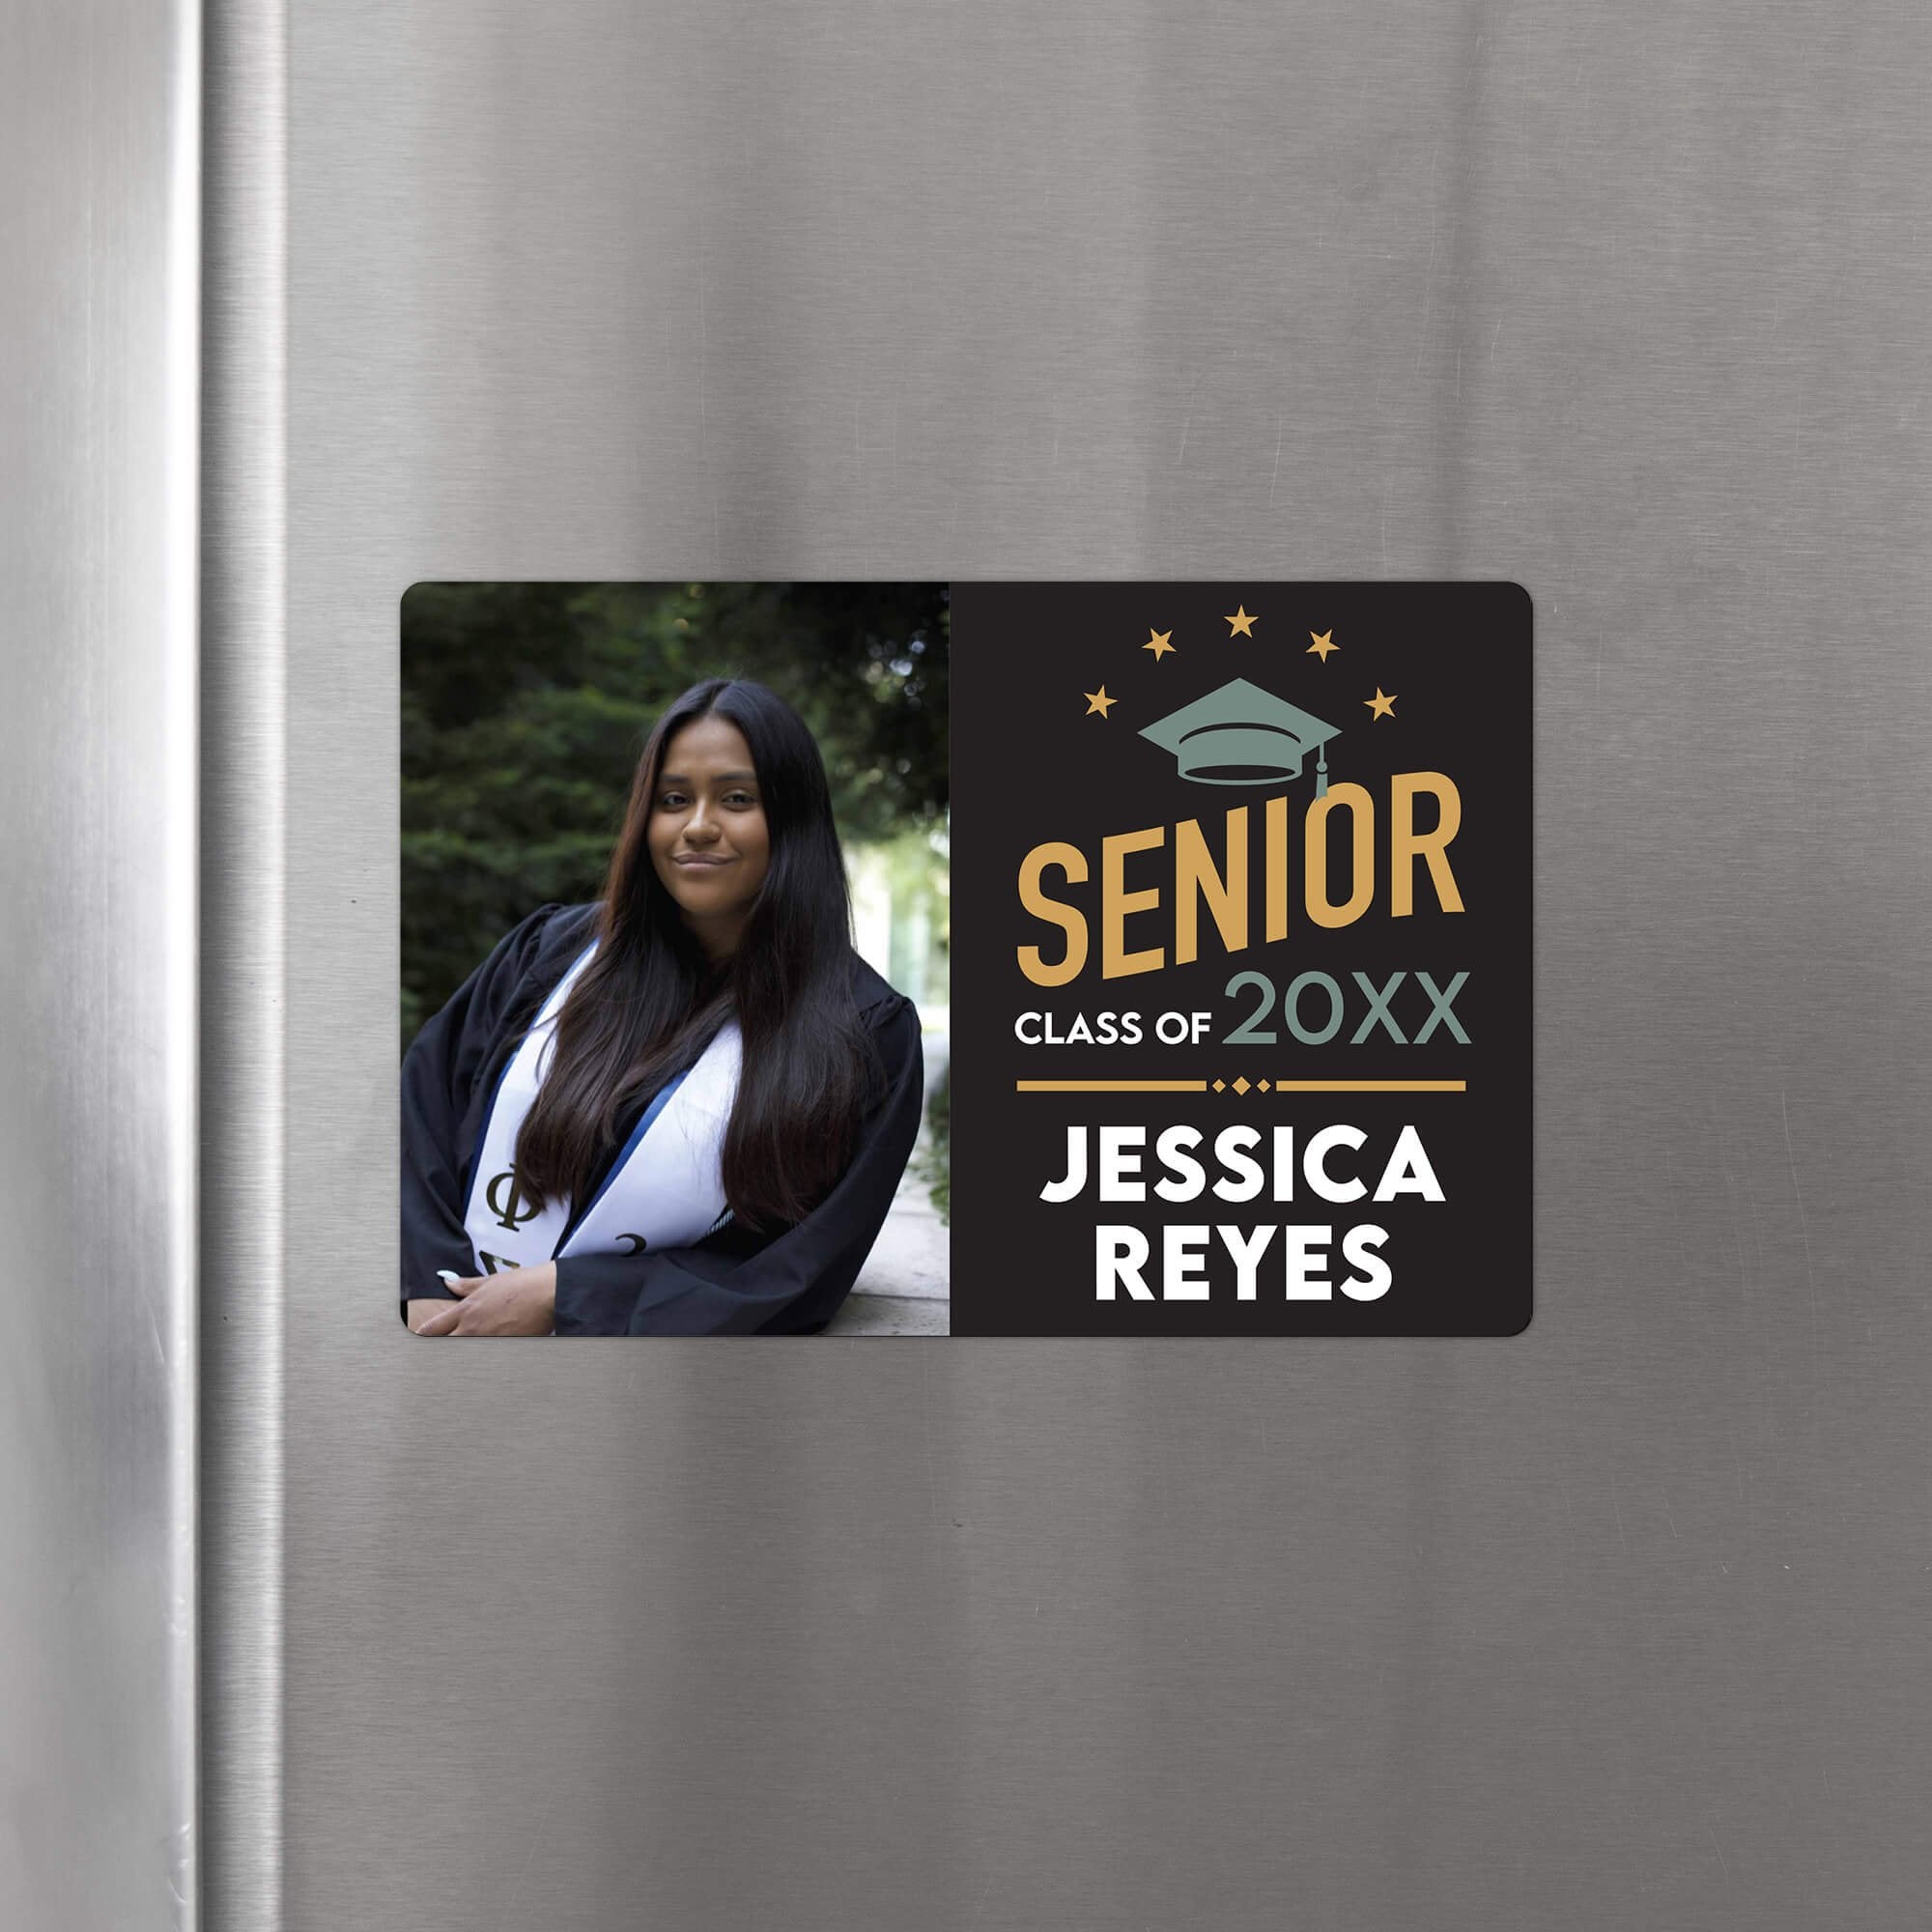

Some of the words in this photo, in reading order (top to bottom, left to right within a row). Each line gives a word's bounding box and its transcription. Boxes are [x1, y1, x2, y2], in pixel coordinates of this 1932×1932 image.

[1016, 771, 1465, 987] SENIOR
[1013, 1011, 1144, 1045] CLASS
[1154, 1011, 1212, 1045] OF
[1221, 971, 1472, 1045] 20XX
[1038, 1124, 1447, 1204] JESSICA
[1095, 1223, 1393, 1302] REYES
